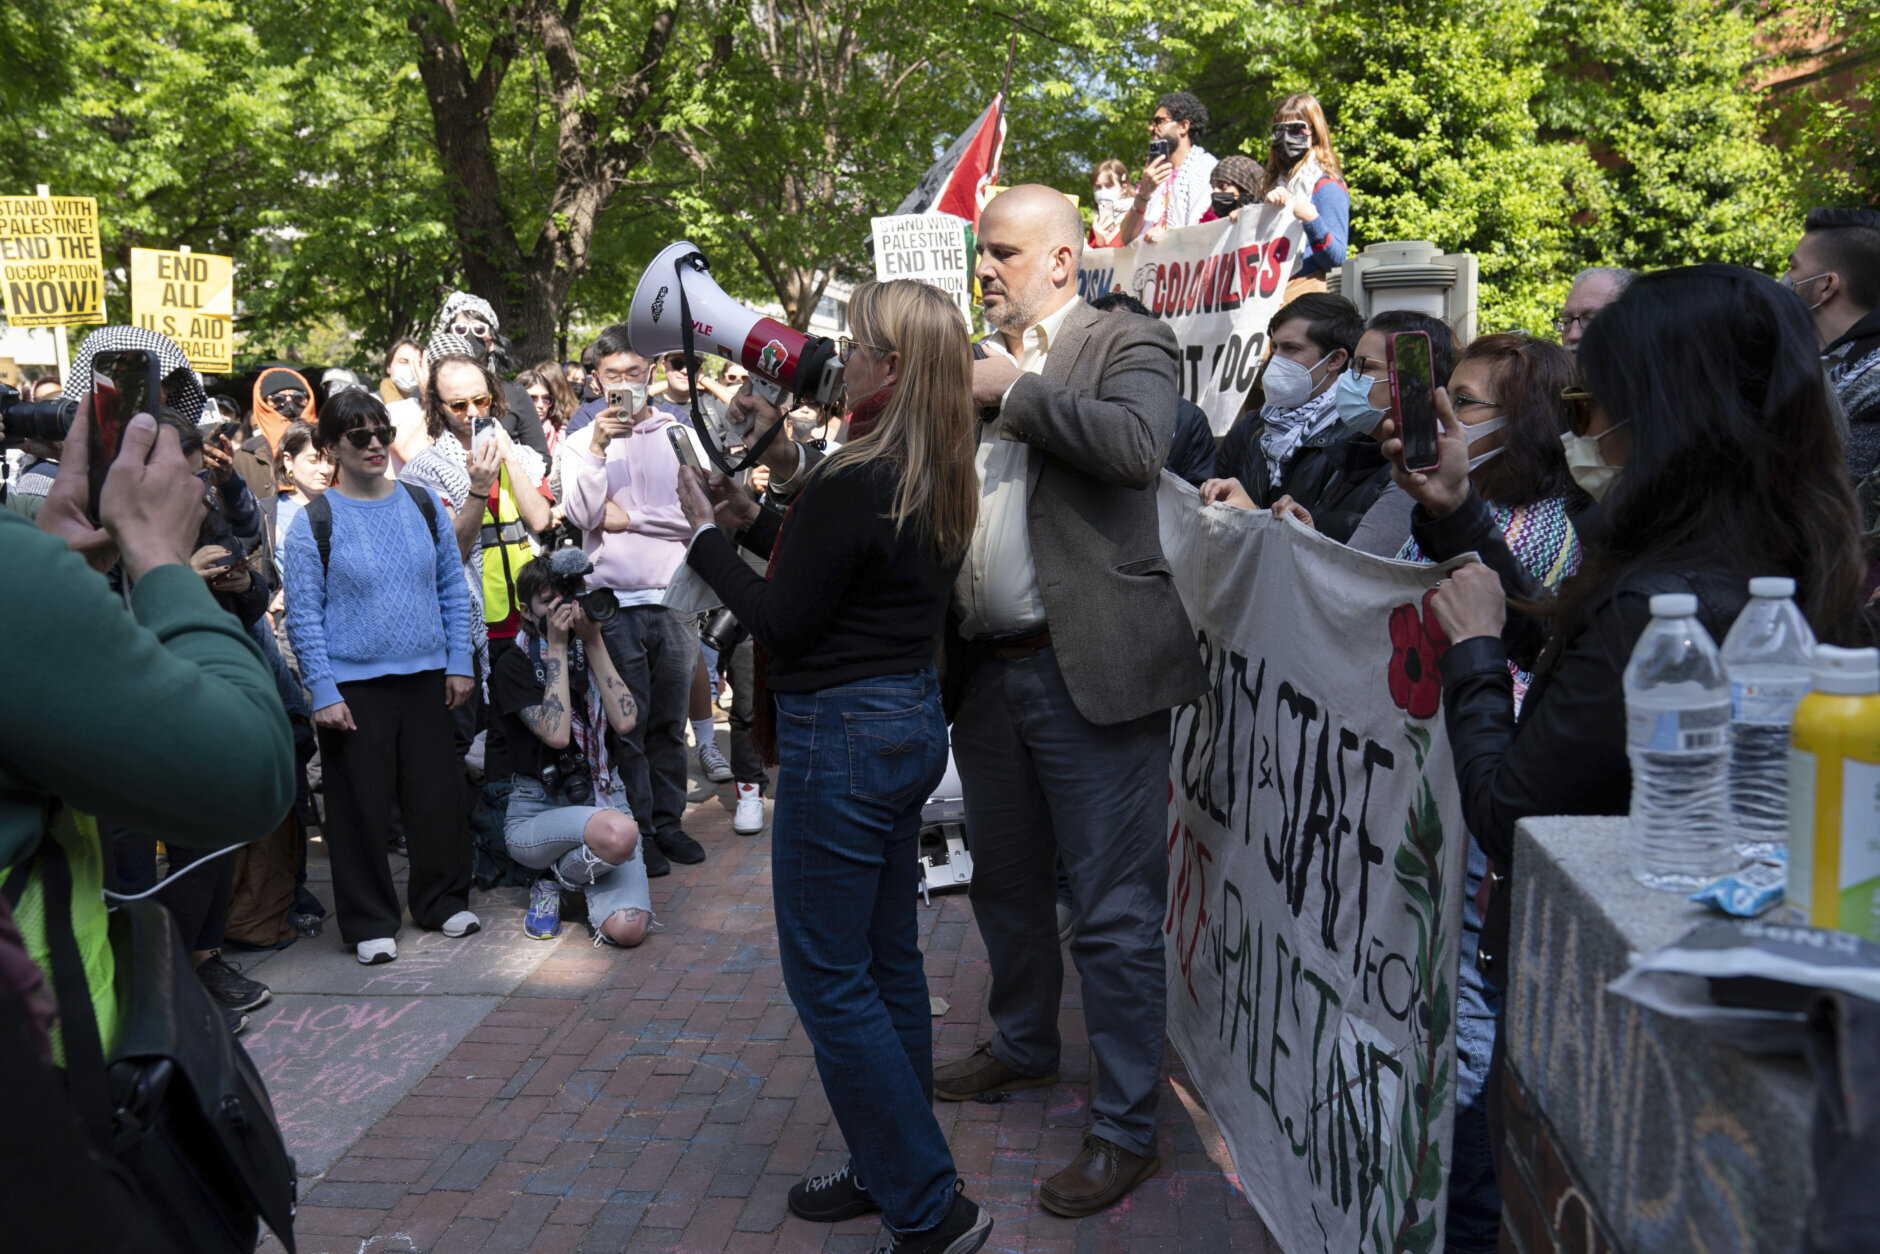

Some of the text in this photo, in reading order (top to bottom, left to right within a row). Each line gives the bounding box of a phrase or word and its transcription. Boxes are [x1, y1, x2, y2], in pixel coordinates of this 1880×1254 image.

[52, 200, 92, 216] WITH
[0, 217, 94, 235] PALESTINE!
[880, 216, 959, 233] STAND WITH
[0, 236, 97, 260] END THE
[882, 231, 961, 251] PALESTINE!
[4, 264, 98, 280] OCCUPATION
[158, 254, 208, 283] END
[885, 249, 965, 275] END THE
[9, 280, 98, 315] NOW!
[162, 282, 205, 309] ALL
[189, 317, 224, 340] AID
[1219, 331, 1265, 394] DC
[1258, 735, 1274, 790] &
[1264, 681, 1395, 978] STAFF
[1363, 935, 1422, 1043] FOR
[261, 1000, 423, 1033] HOW
